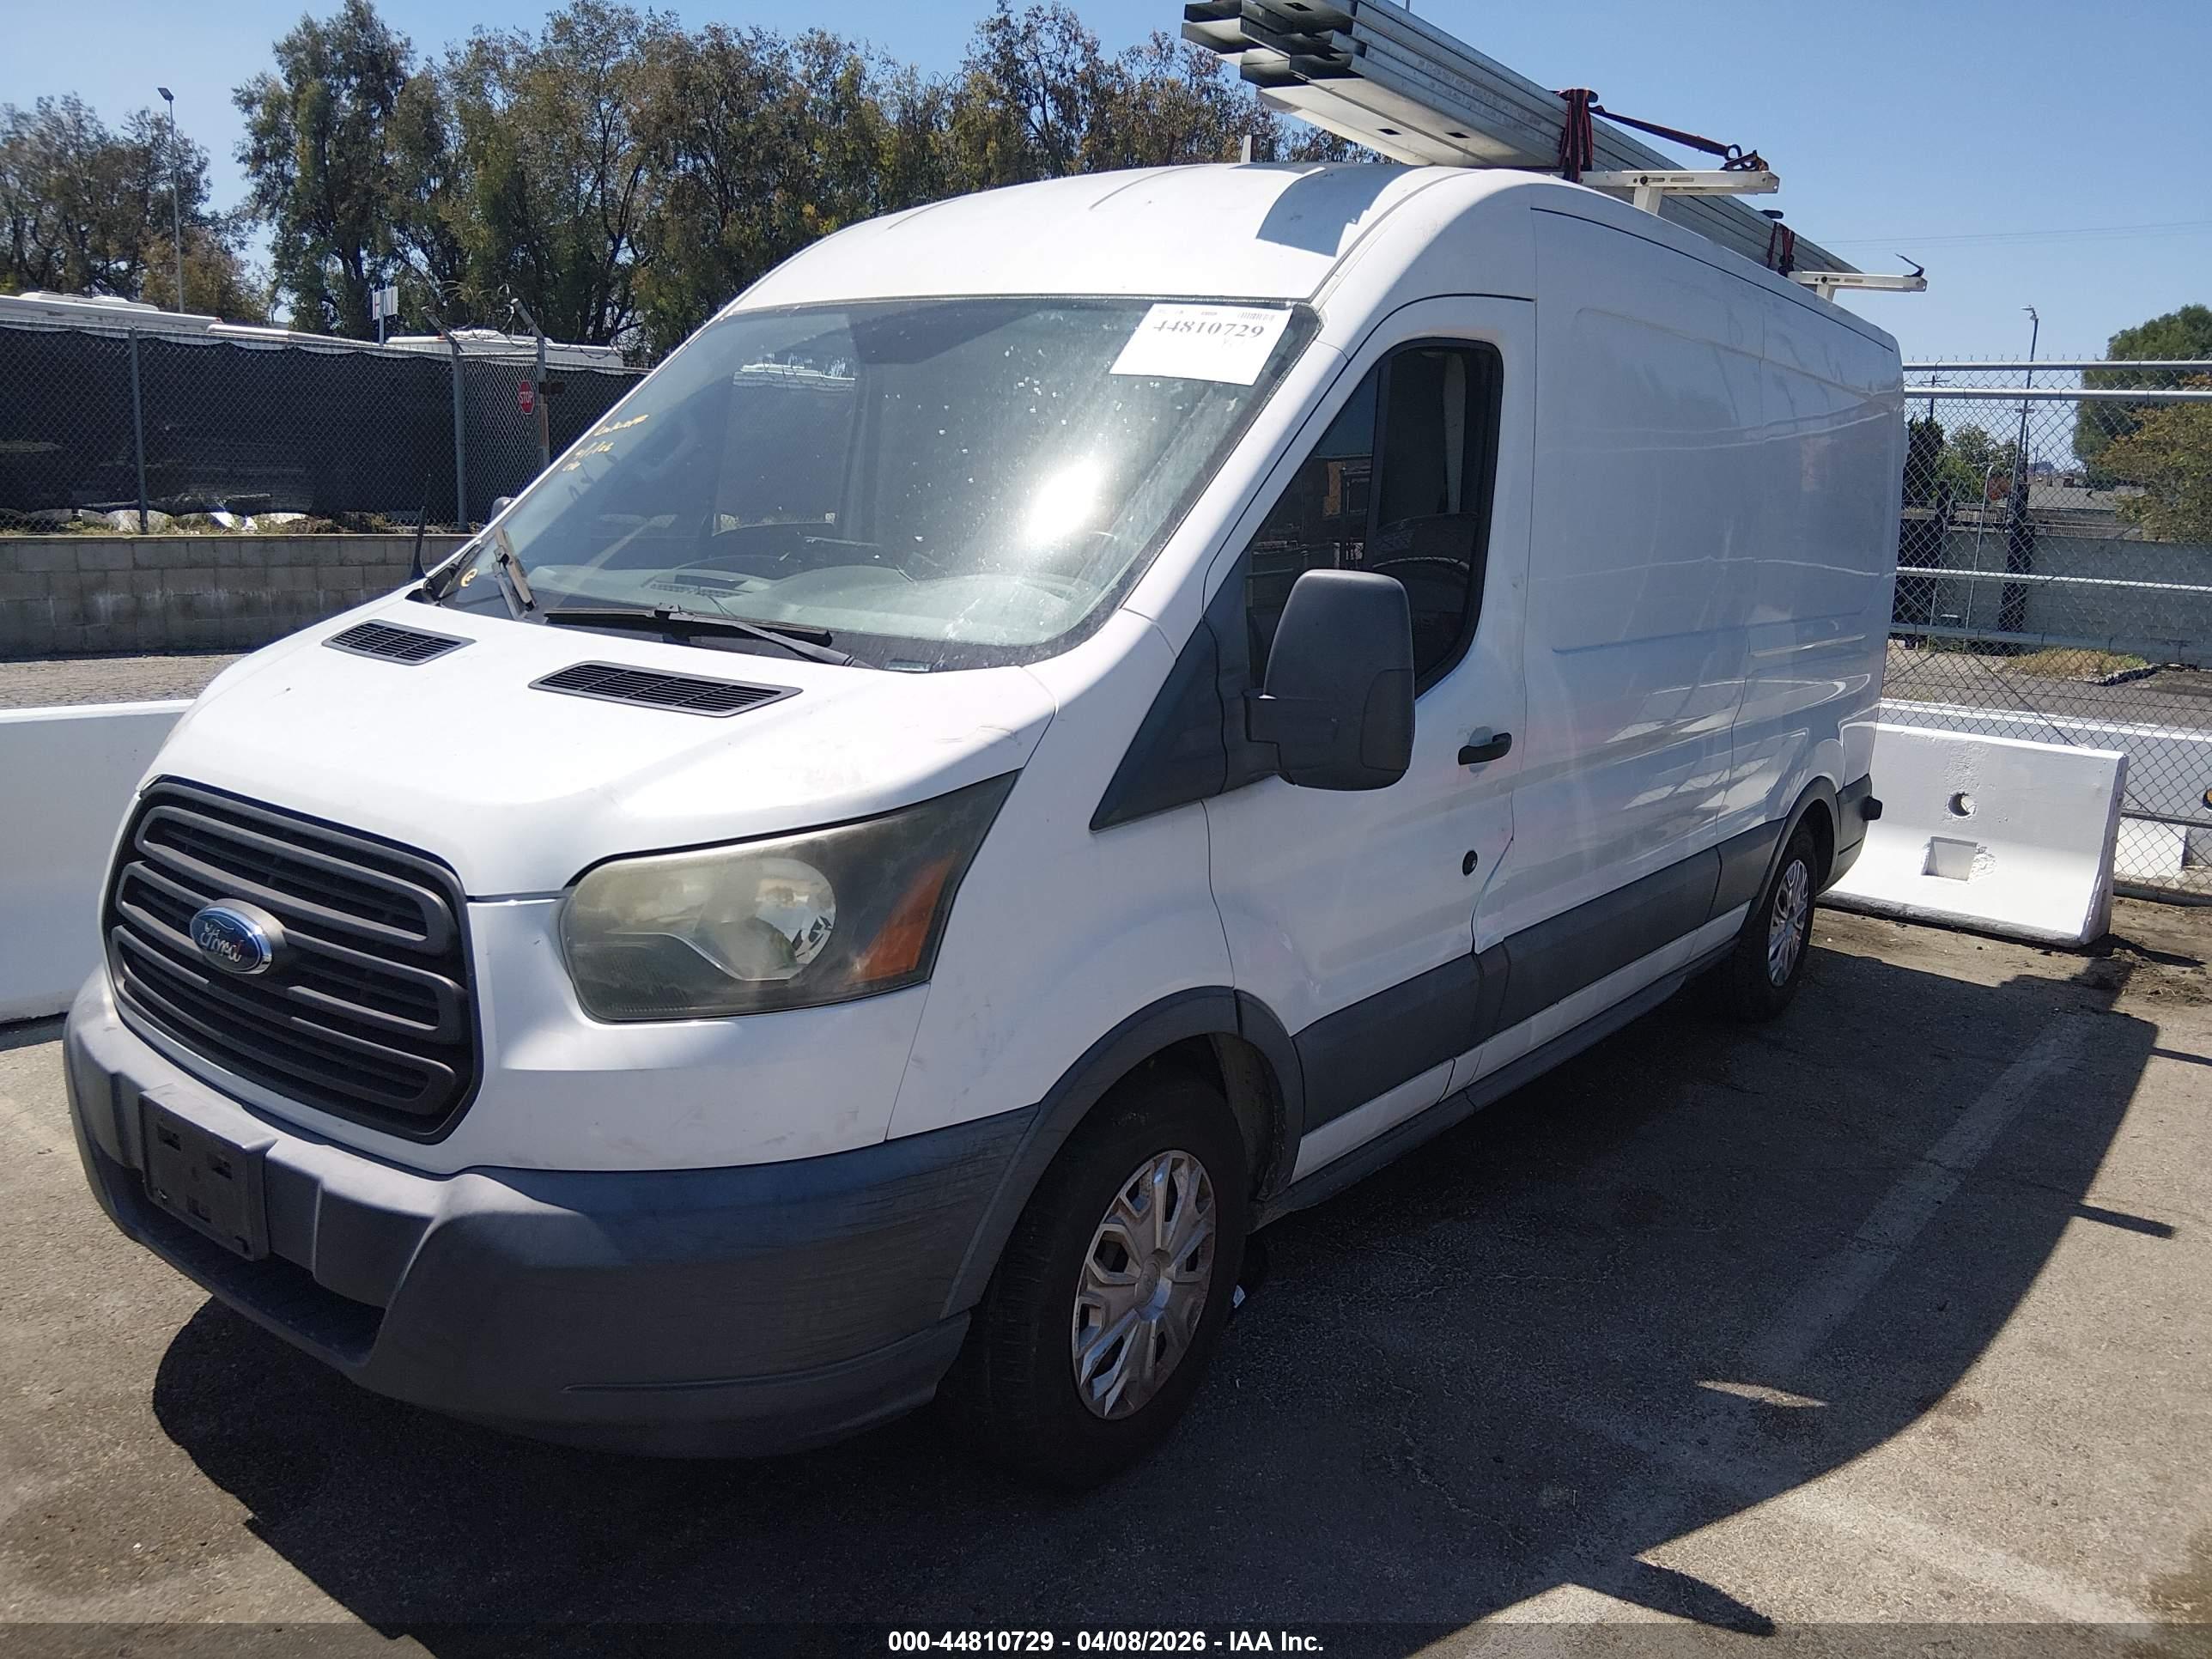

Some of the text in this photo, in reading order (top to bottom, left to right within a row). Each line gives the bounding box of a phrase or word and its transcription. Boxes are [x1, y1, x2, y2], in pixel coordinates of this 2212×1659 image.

[1153, 319, 1265, 338] 44810729
[519, 391, 533, 405] STOP
[199, 922, 246, 963] Ford
